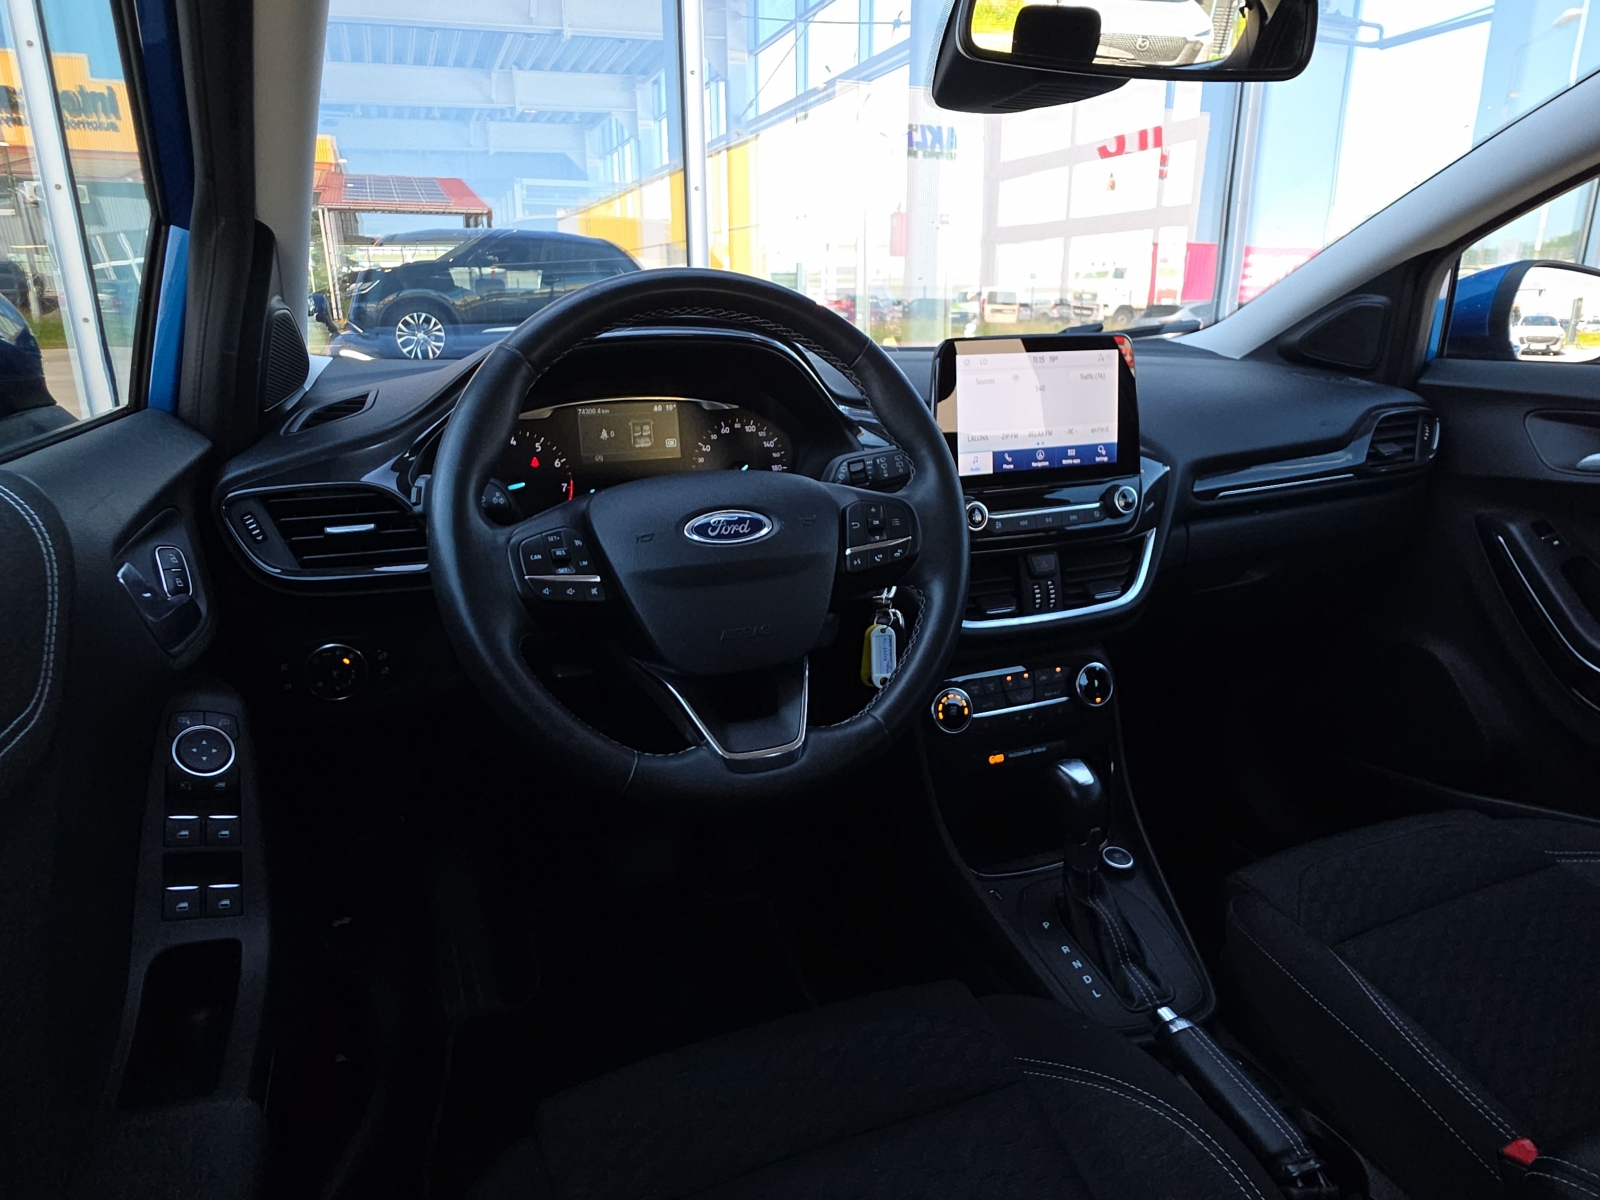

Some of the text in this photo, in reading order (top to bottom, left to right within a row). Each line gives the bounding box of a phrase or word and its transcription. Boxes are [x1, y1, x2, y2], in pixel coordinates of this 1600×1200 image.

[510, 436, 516, 446] 4
[535, 443, 542, 452] 5
[554, 458, 561, 467] 6
[561, 483, 567, 492] 7
[706, 516, 752, 537] Ford
[1042, 921, 1050, 929] P
[1061, 945, 1071, 954] R
[1072, 959, 1082, 969] N
[1082, 974, 1092, 984] D
[1092, 989, 1101, 998] L
